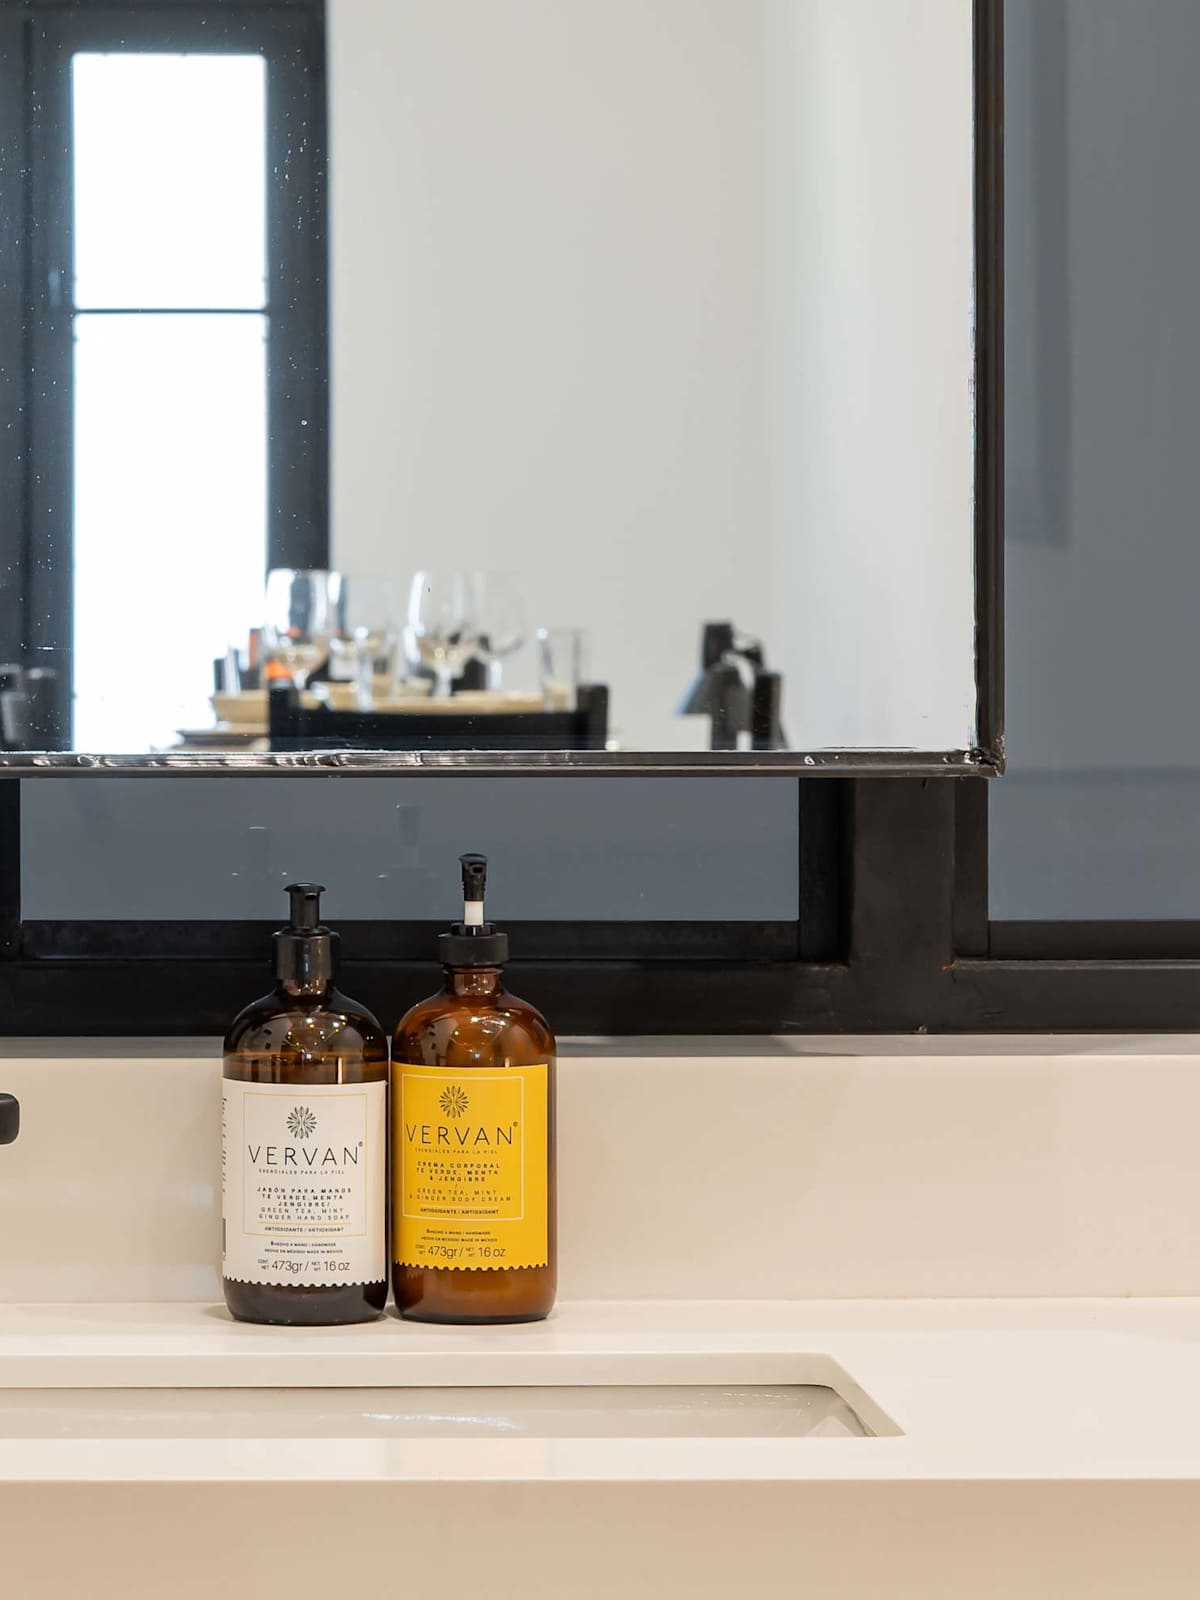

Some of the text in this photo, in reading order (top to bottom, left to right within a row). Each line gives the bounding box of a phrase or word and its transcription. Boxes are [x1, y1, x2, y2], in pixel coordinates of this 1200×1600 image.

[405, 1123, 512, 1146] VERVAN
[248, 1144, 358, 1166] VERVAN
[427, 1245, 457, 1259] 473gr
[478, 1247, 491, 1257] 16
[492, 1247, 506, 1257] oz
[271, 1260, 303, 1274] 473gr
[324, 1260, 336, 1271] 16
[338, 1261, 350, 1271] oz
